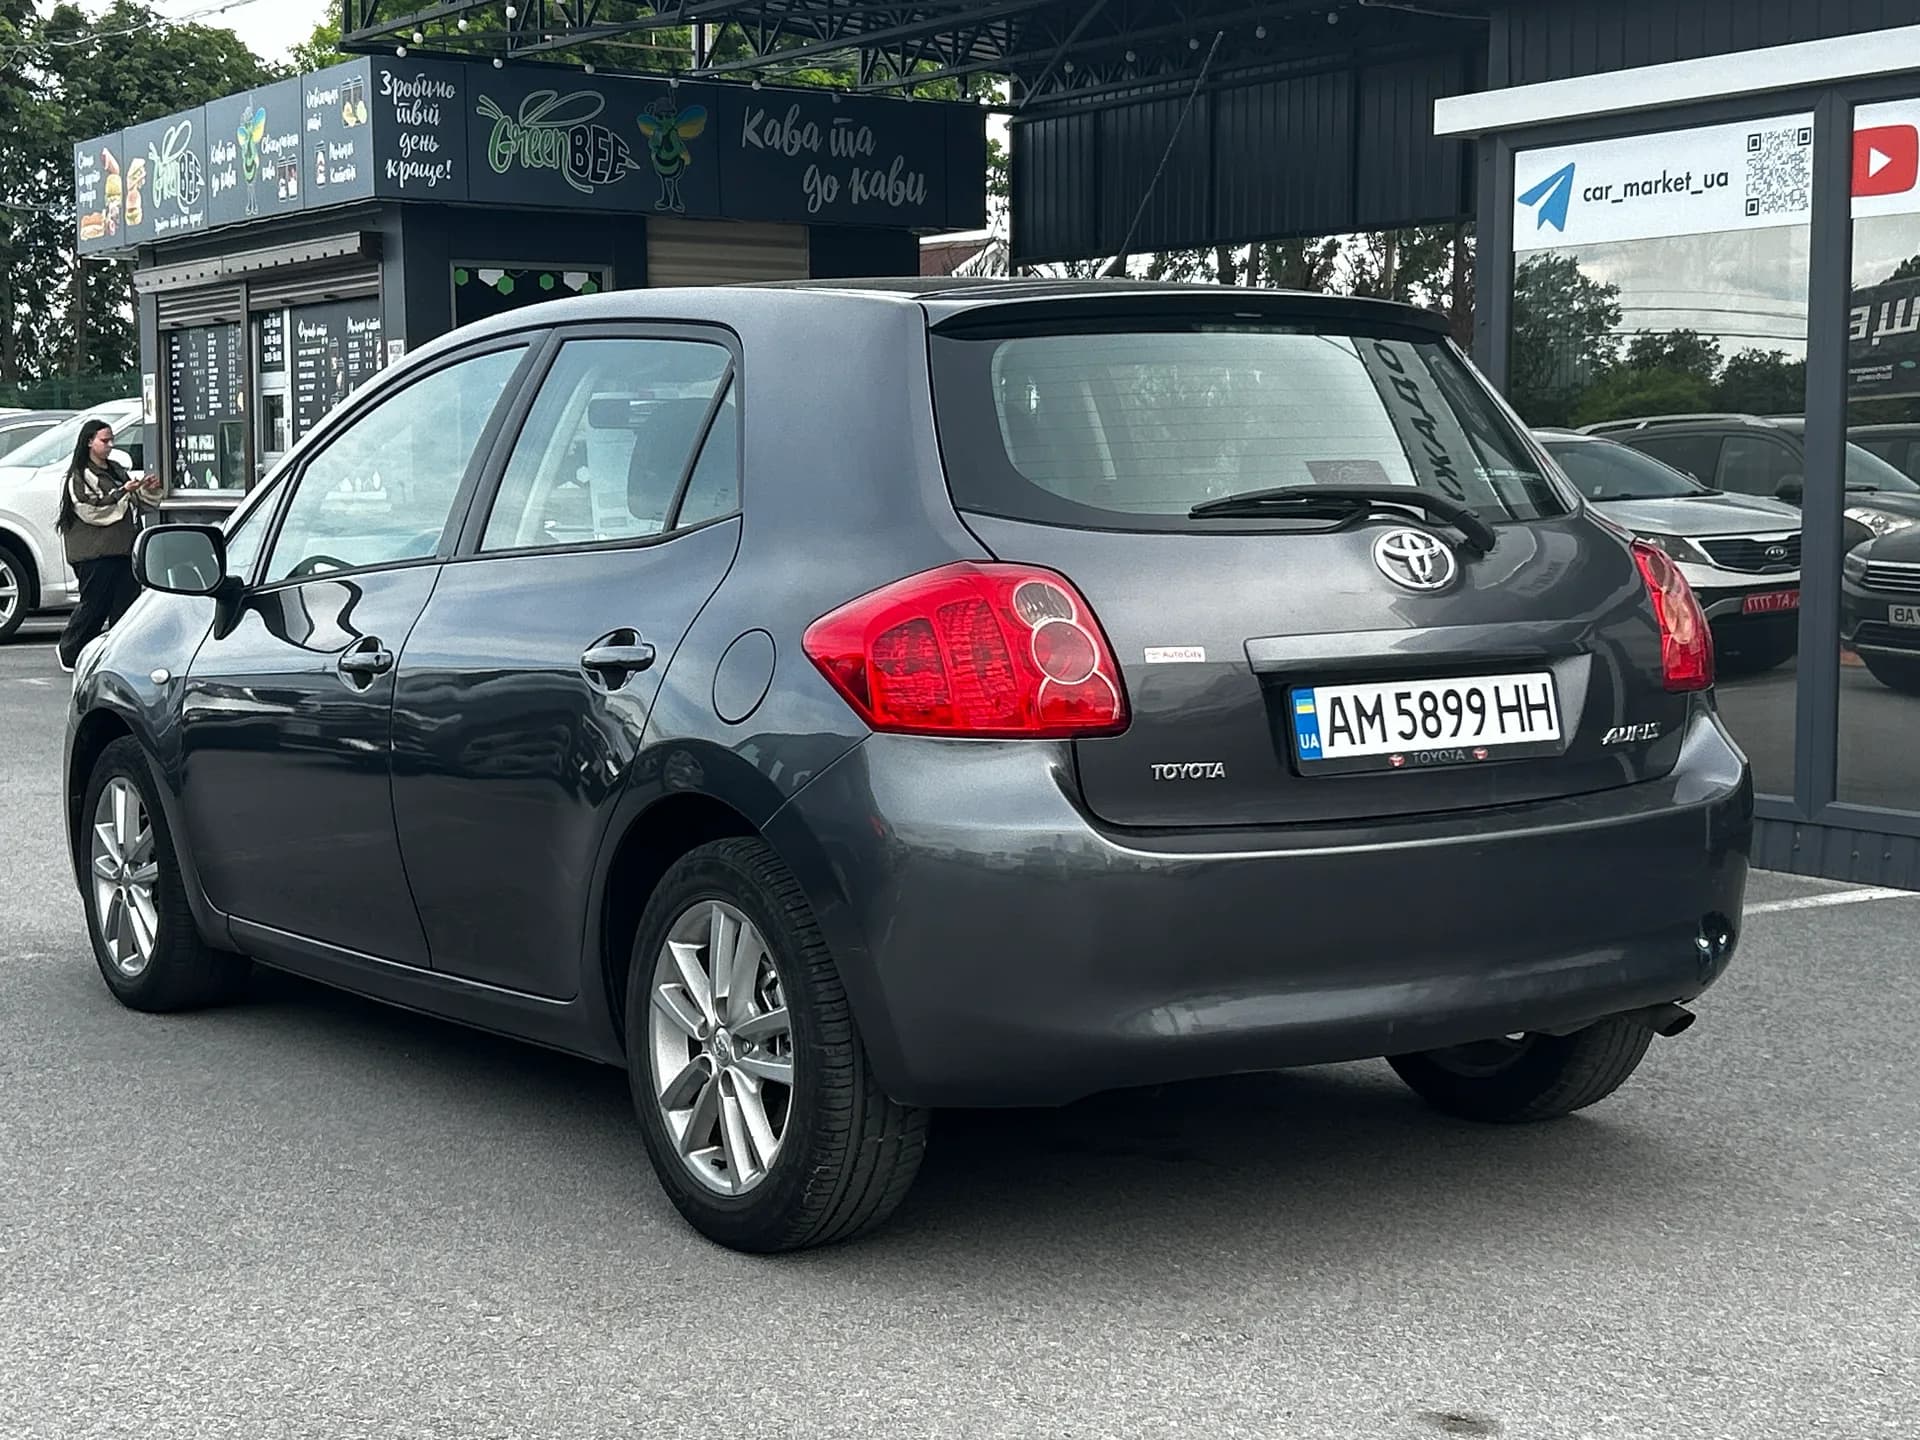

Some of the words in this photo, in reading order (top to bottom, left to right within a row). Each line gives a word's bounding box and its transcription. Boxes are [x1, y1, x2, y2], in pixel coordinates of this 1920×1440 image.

[379, 70, 456, 106] Зробимо
[396, 98, 441, 126] твій
[399, 132, 440, 159] день
[742, 103, 824, 157] Кава
[829, 117, 877, 159] та
[488, 115, 633, 193] GreenBEE
[384, 159, 452, 189] краще!
[802, 164, 840, 213] до
[848, 155, 927, 207] кави
[1583, 169, 1729, 204] car_market_ua
[1328, 693, 1388, 747] AM
[1394, 687, 1486, 741] 5899
[1493, 683, 1554, 734] HH
[1299, 733, 1320, 749] UA
[1412, 749, 1466, 764] TOYOTA
[1151, 762, 1226, 780] TOYOTA
